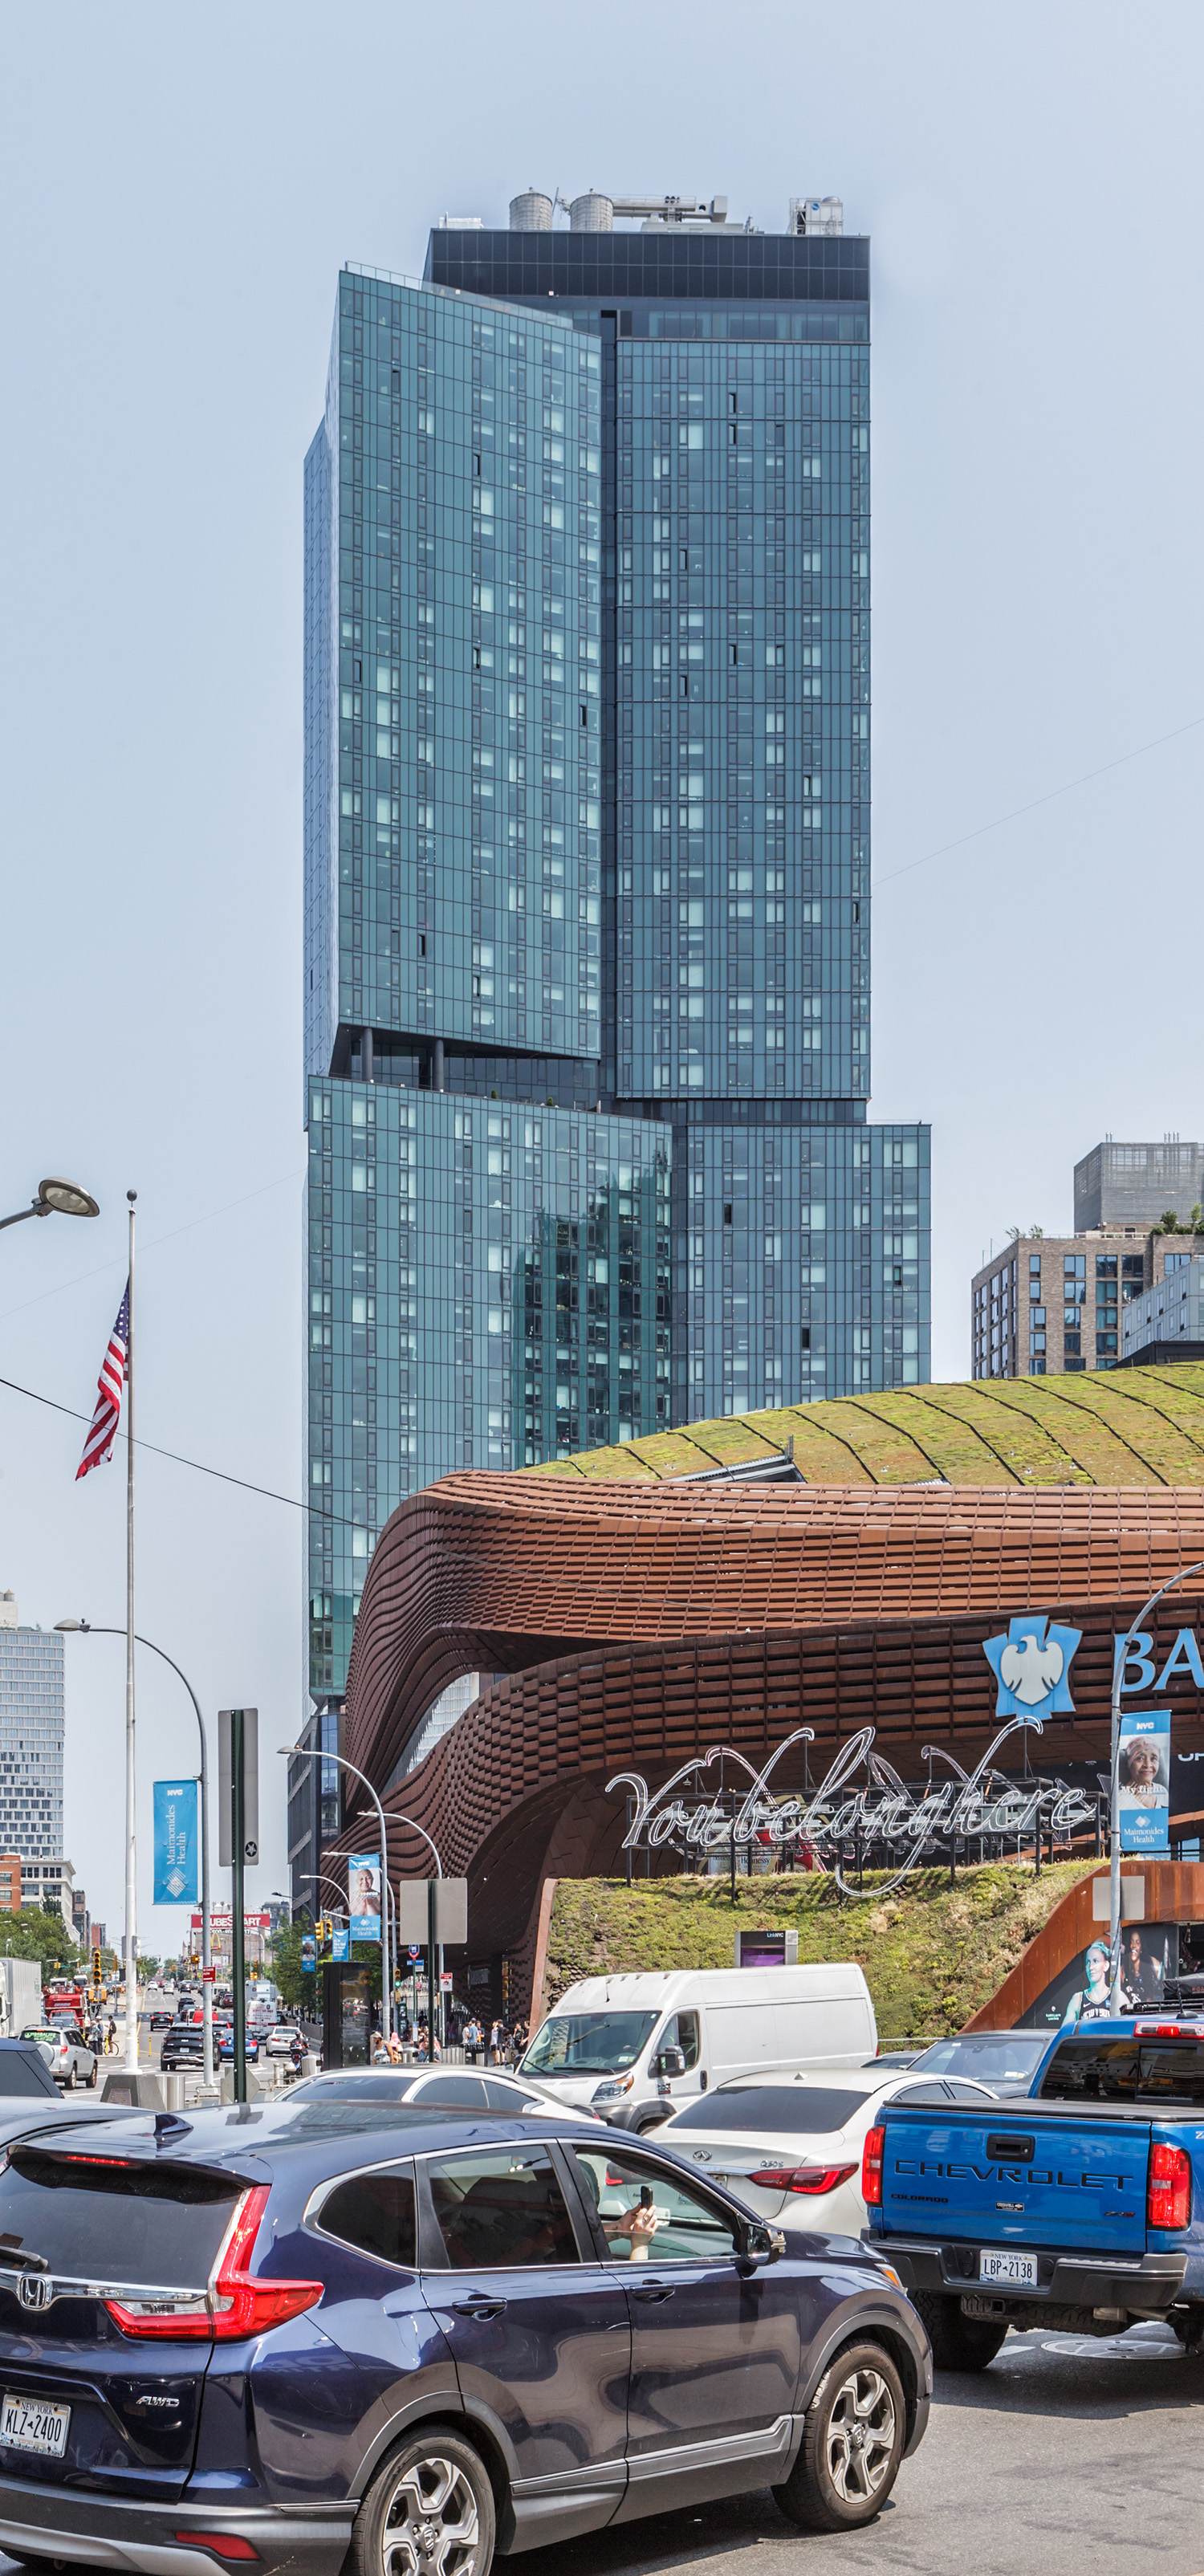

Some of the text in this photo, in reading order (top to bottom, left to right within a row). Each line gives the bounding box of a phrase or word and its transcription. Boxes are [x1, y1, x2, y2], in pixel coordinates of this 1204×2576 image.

[1137, 1722, 1154, 1730] NYC
[1121, 1785, 1136, 1795] My
[605, 1715, 1097, 1896] You belong here
[166, 1805, 176, 1865] Maimonides
[1124, 1827, 1164, 1836] Maimonides
[1133, 1835, 1155, 1843] Health
[177, 1832, 186, 1865] Health
[895, 2159, 1133, 2190] CHEVROLET
[891, 2193, 949, 2203] COLORADO
[136, 2395, 180, 2407] AWD
[21, 2402, 54, 2415] NEW YORK
